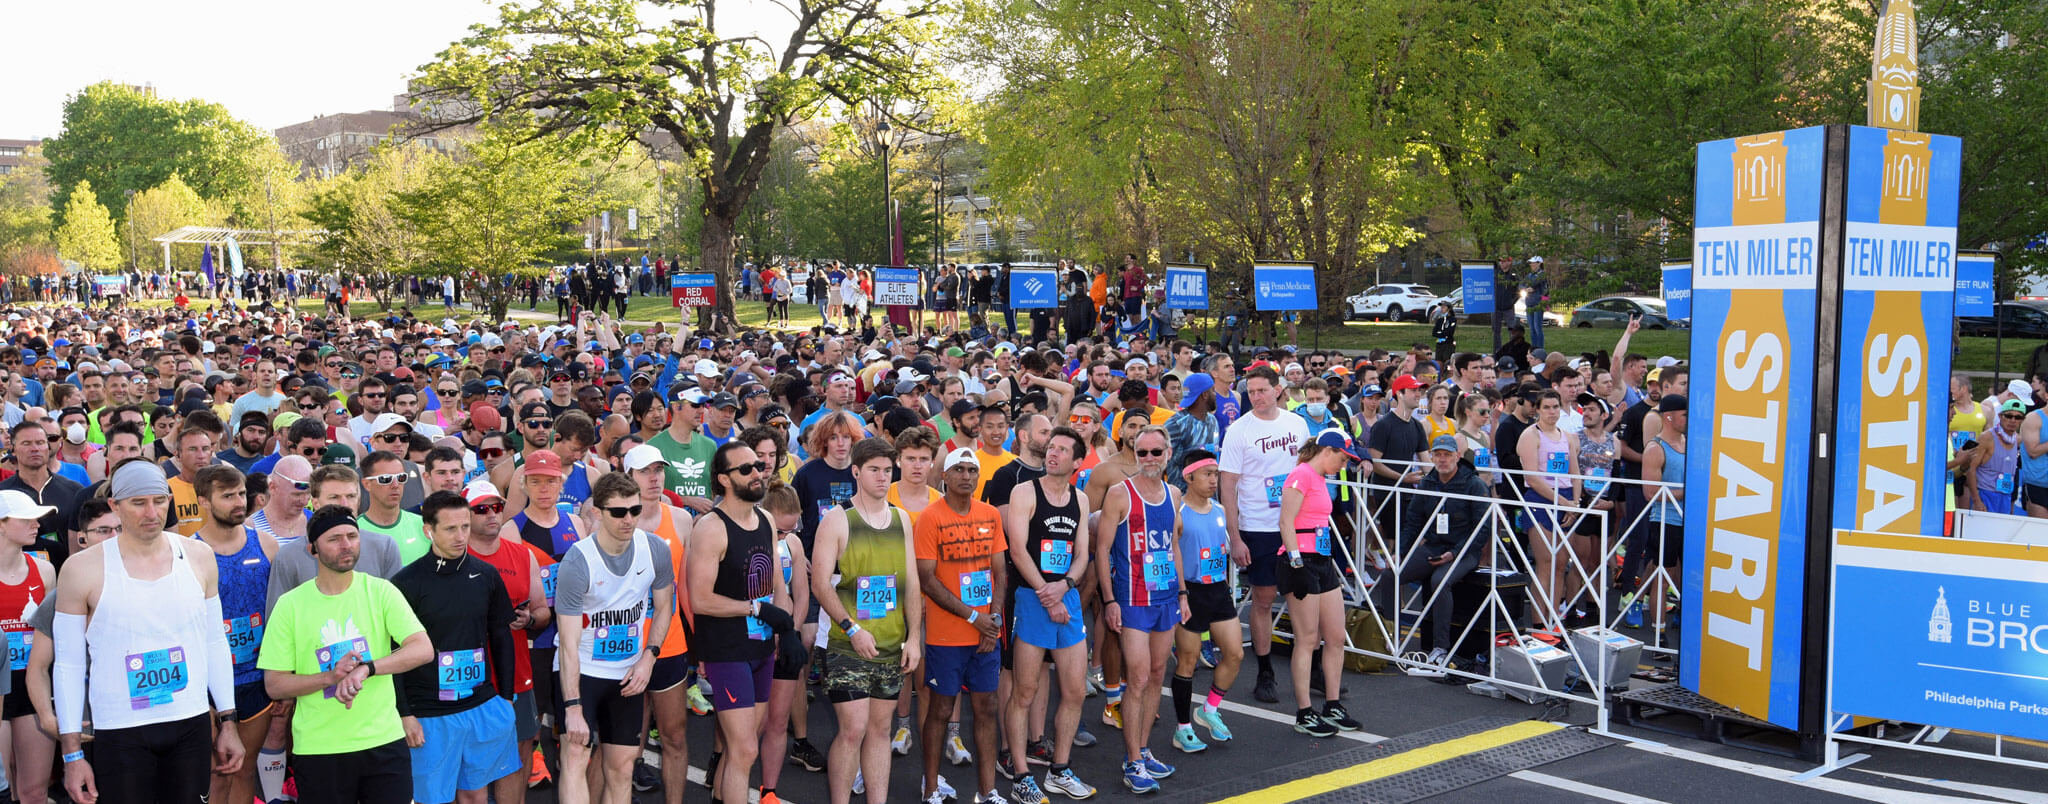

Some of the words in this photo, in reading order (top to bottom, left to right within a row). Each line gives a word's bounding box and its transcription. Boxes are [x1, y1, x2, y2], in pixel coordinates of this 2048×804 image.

[1698, 240, 1738, 276] TEN
[1747, 237, 1813, 276] MILER
[1849, 237, 1883, 277] TEN
[1889, 239, 1951, 278] MILER
[686, 287, 702, 297] RED
[888, 282, 906, 293] ELITE
[1171, 274, 1204, 297] ACME
[1286, 280, 1312, 290] Medicine
[1973, 281, 1990, 289] RUN
[679, 296, 711, 307] CORRAL
[880, 294, 914, 305] ATHLETES
[1255, 431, 1299, 454] Temple
[1552, 460, 1566, 471] 971
[675, 485, 706, 496] RWB
[1704, 329, 1784, 672] START
[177, 503, 199, 517] TWO
[1043, 515, 1061, 527] INSIDE
[1061, 515, 1078, 529] TRACK
[1048, 524, 1073, 536] Running
[1050, 553, 1068, 567] 527
[1208, 557, 1224, 571] 736
[1152, 563, 1170, 577] 815
[862, 589, 892, 604] 2124
[1968, 599, 2031, 618] BLUE
[228, 629, 255, 648] 554
[1966, 617, 2048, 655] BRO
[599, 638, 633, 654] 1946
[135, 665, 181, 689] 2004
[445, 664, 480, 682] 2190
[1925, 689, 2006, 710] Philadelphia
[2009, 700, 2048, 716] Parks
